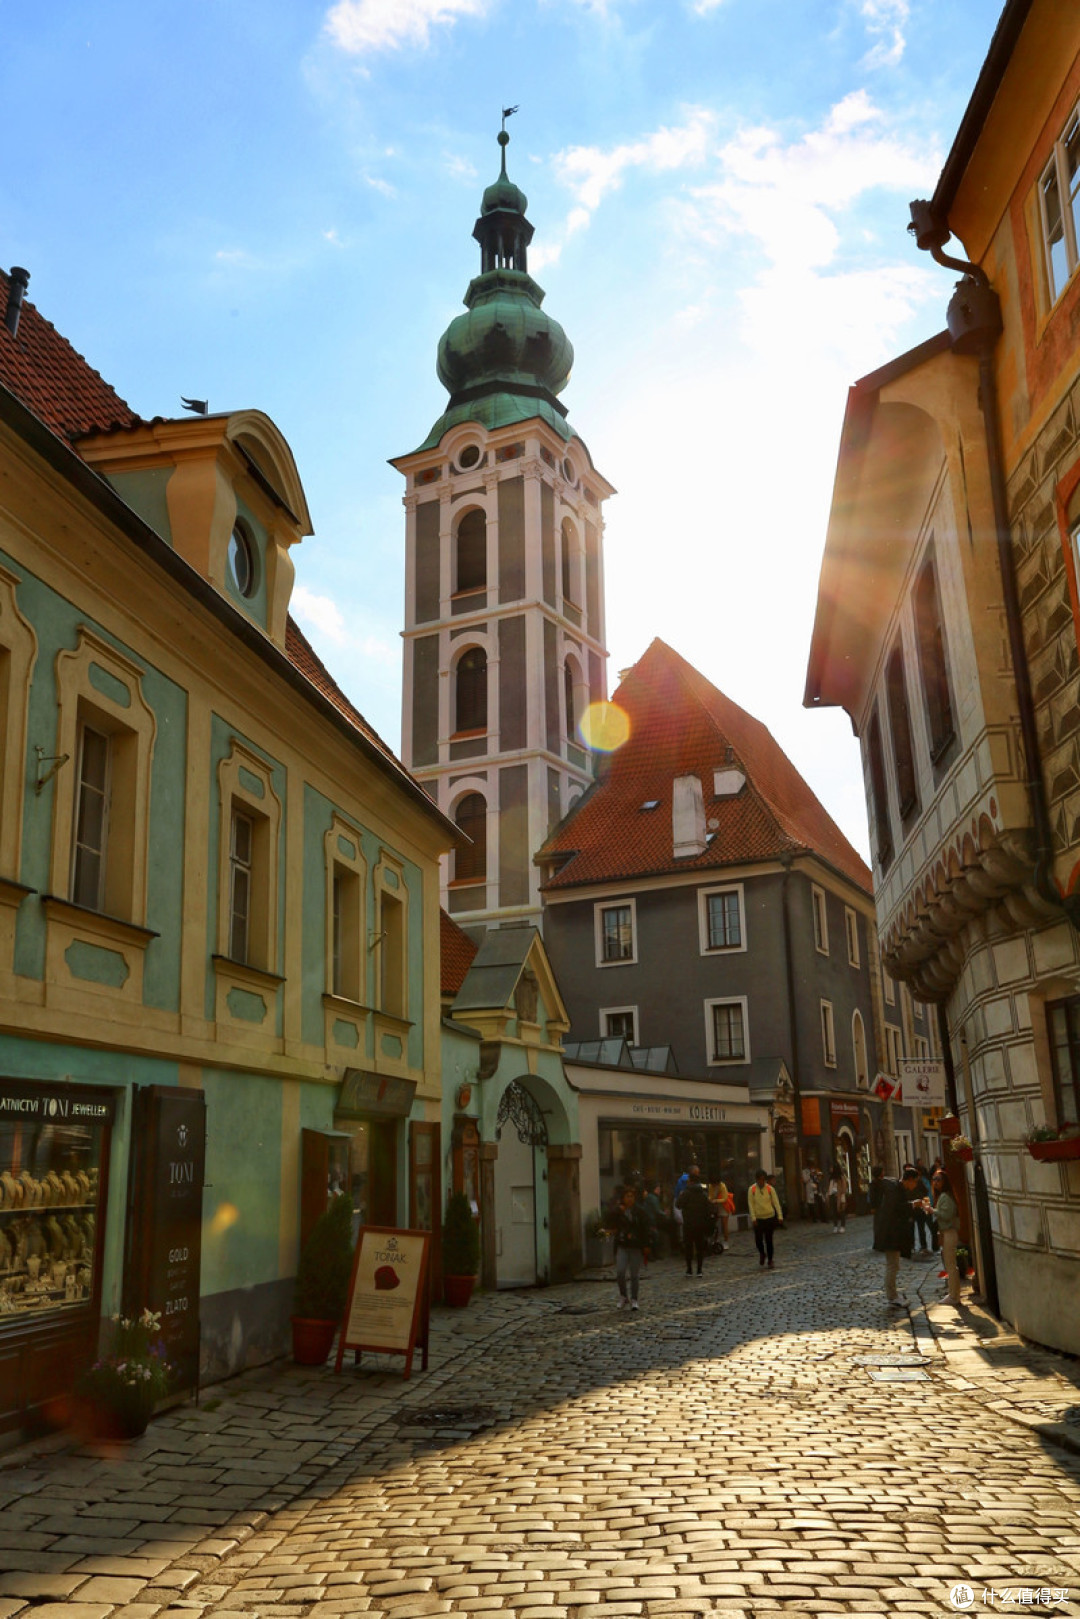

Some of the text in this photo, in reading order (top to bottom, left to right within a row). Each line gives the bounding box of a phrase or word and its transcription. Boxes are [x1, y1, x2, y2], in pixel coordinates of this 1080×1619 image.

[0, 1096, 39, 1112] ATNICTVÍ
[42, 1097, 69, 1117] TONI
[169, 1161, 194, 1184] TONI
[168, 1247, 189, 1263] GOLD
[375, 1251, 408, 1264] TONAK
[165, 1296, 189, 1315] ZLATO
